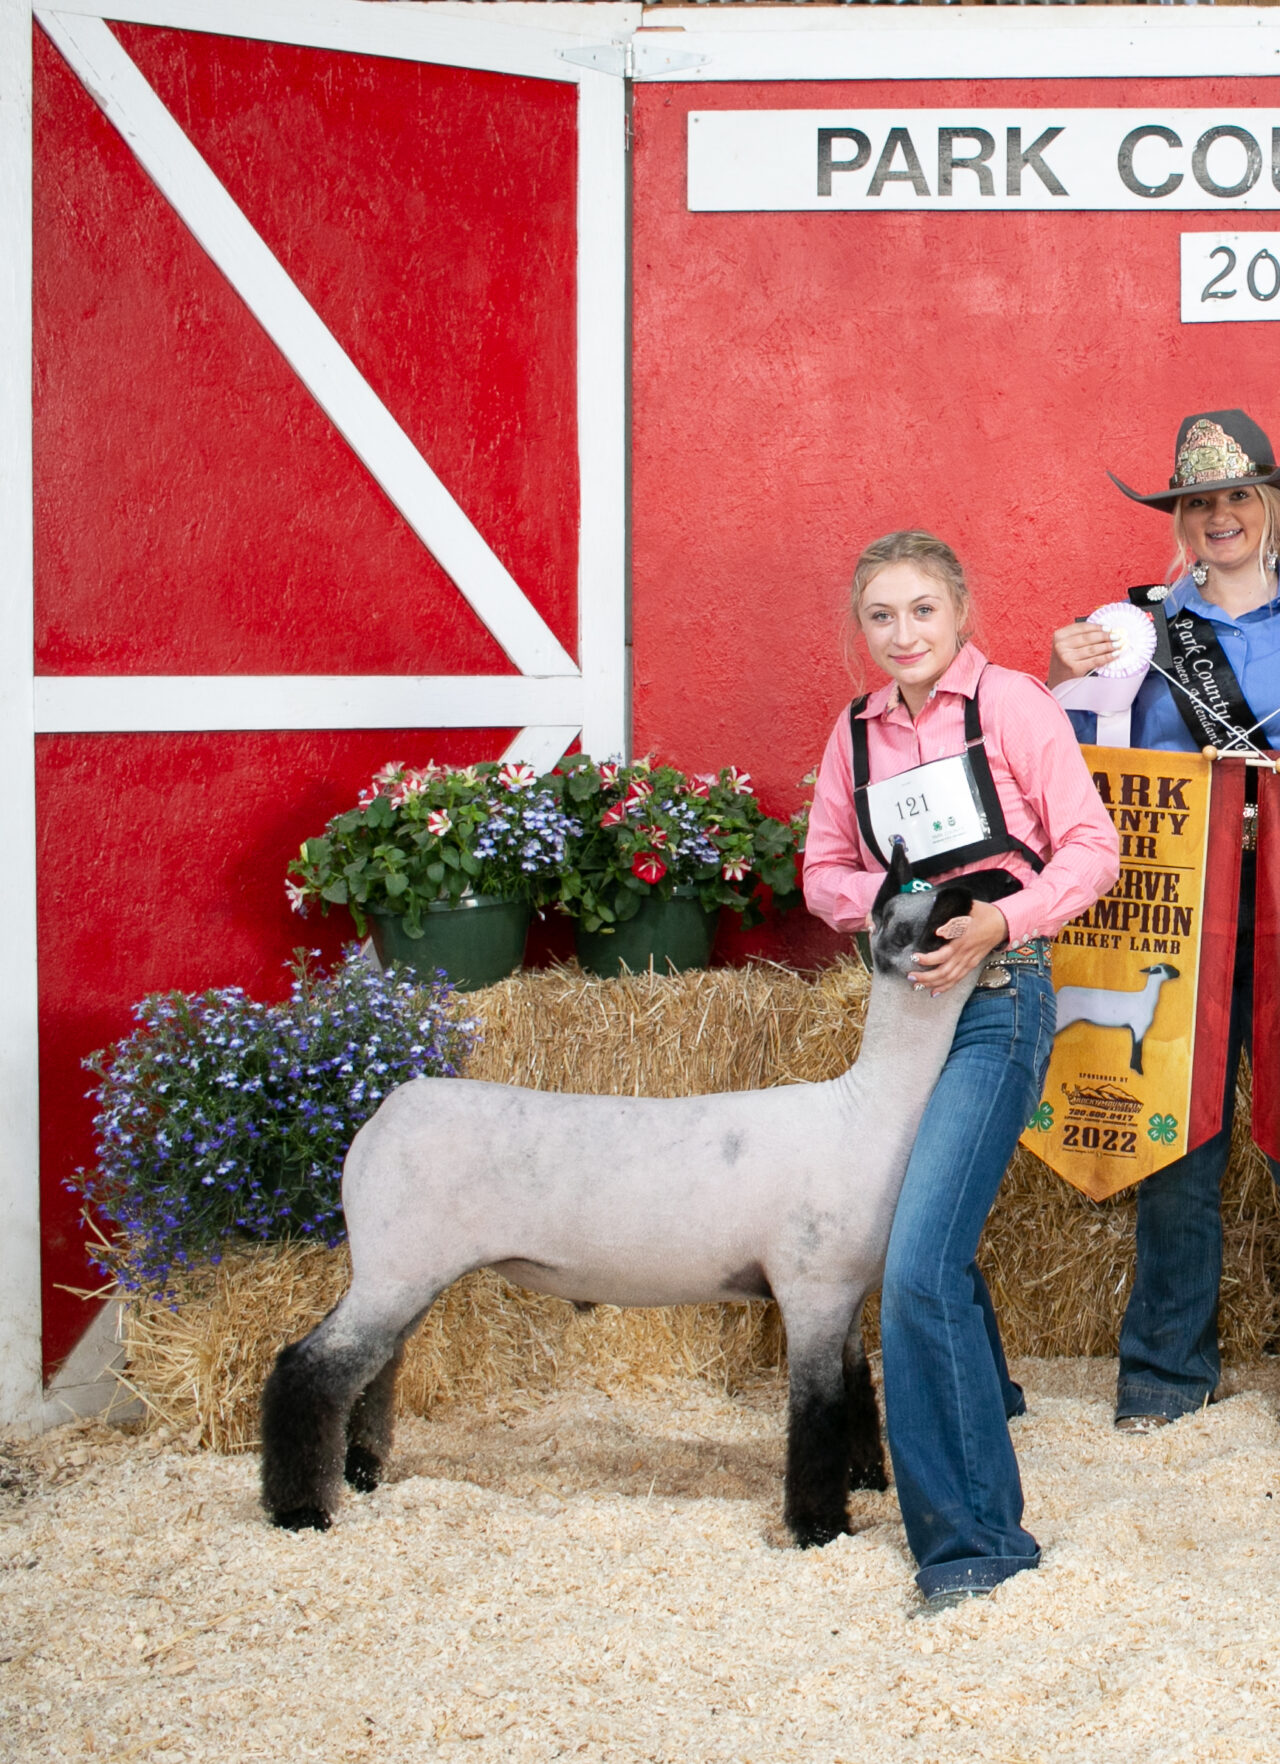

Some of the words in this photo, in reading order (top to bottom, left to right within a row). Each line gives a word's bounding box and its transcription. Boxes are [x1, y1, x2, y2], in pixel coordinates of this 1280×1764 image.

[817, 126, 1070, 197] PARK
[1174, 618, 1207, 659] Park
[1192, 658, 1232, 721] County
[1172, 656, 1190, 685] Queen
[1188, 687, 1223, 745] Attendant
[895, 792, 931, 820] 121
[1092, 771, 1193, 810] ARK
[1119, 834, 1157, 860] IR
[1105, 868, 1181, 903] ERVE
[1067, 898, 1194, 937] AMPION
[1129, 936, 1181, 955] LAMB
[1062, 1124, 1137, 1153] 2022
